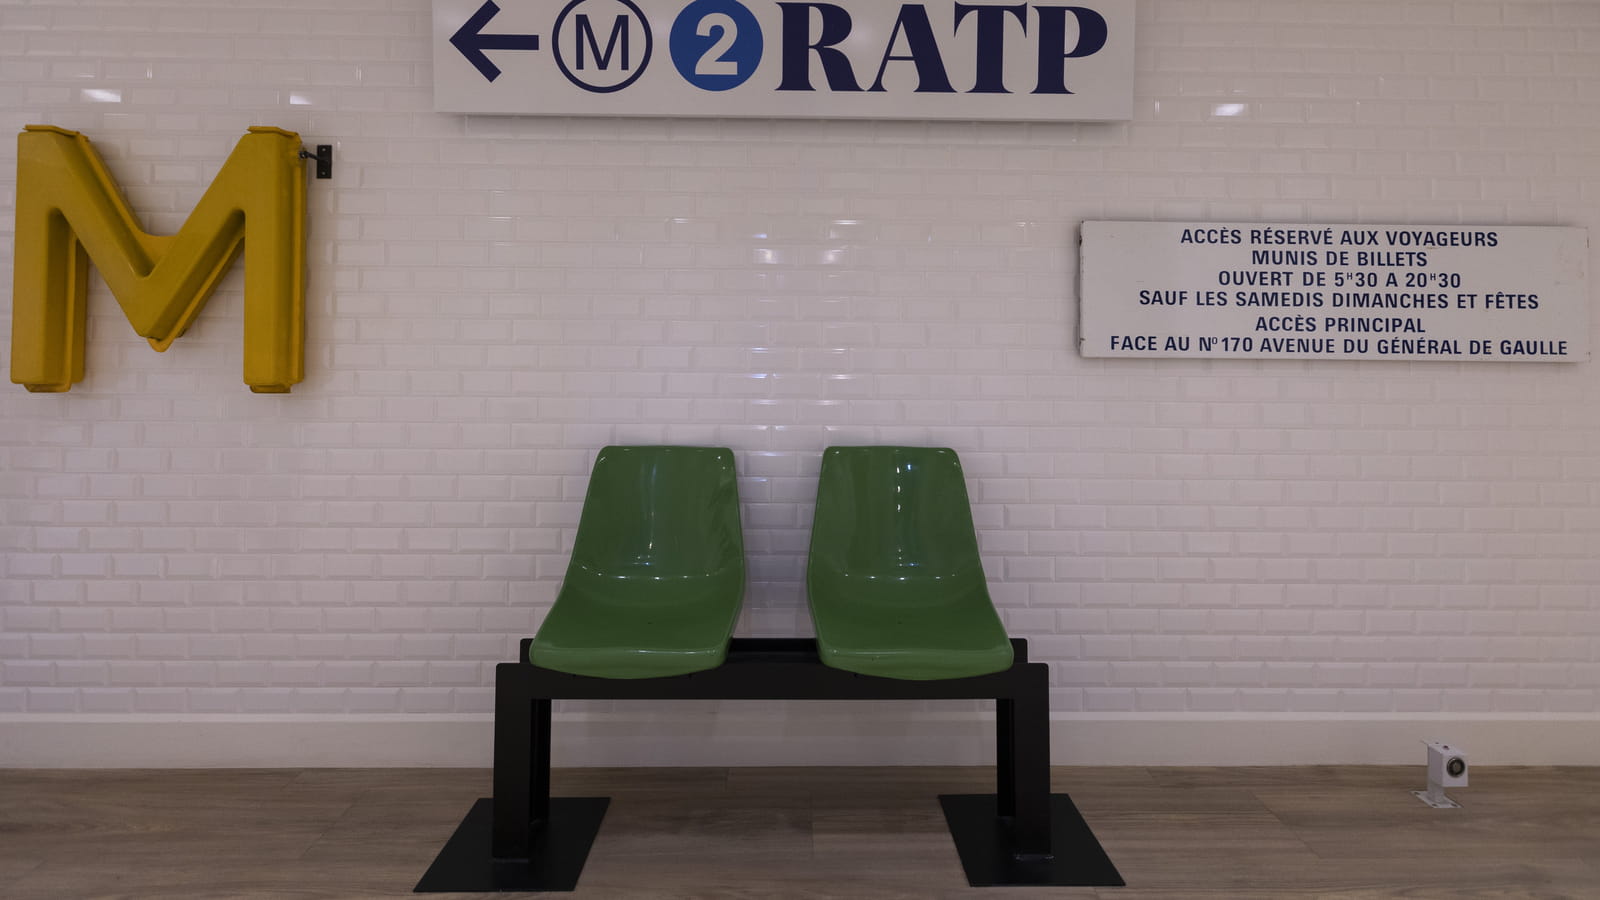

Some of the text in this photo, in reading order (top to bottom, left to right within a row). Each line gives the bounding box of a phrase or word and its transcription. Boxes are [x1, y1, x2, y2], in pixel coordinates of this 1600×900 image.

[576, 1, 1107, 94] M 2 RATP
[1180, 226, 1499, 248] ACCÈS RÉSERVÉ AUX VOYAGEURS
[11, 125, 308, 393] M
[1251, 249, 1428, 268] MUNIS DE BILLETS
[1218, 270, 1294, 287] OUVERT
[1302, 271, 1327, 287] DE
[1385, 272, 1399, 288] A
[1139, 289, 1539, 310] SAUF LES SAMEDIS DIMANCHES ET FÊTES
[1255, 314, 1426, 334] ACCÈS PRINCIPAL
[1110, 335, 1158, 351] FACE
[1164, 335, 1190, 352] AU
[1259, 337, 1335, 354] AVENUE
[1343, 338, 1369, 354] DU
[1377, 336, 1463, 355] GÉNÉRAL
[1469, 339, 1493, 356] DE
[1499, 339, 1568, 356] GAULLE
